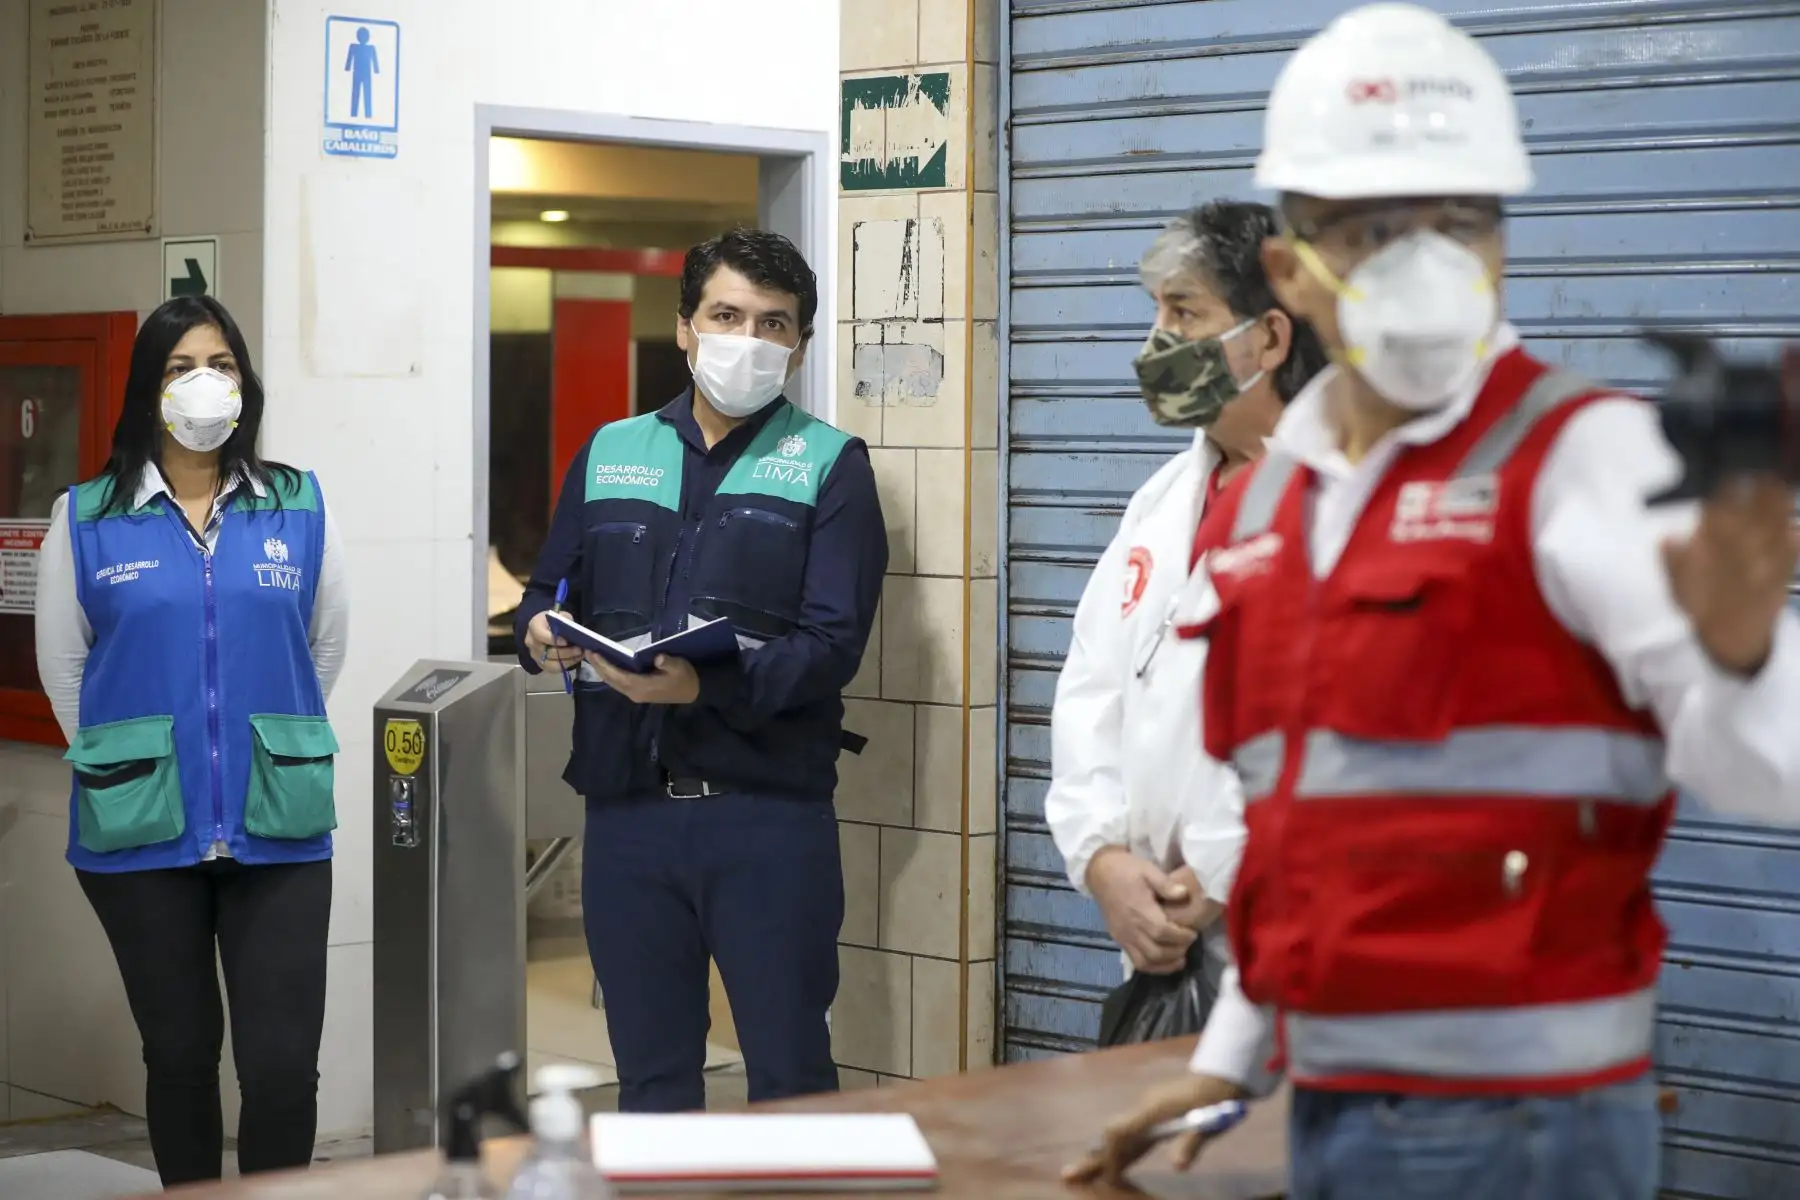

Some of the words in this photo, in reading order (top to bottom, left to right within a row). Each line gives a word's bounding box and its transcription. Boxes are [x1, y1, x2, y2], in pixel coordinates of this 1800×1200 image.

[325, 140, 396, 154] CABALLEROS
[21, 399, 34, 438] 6
[595, 464, 664, 478] DESARROLLO
[752, 464, 809, 486] LIMA
[595, 474, 659, 487] ECONÓMICO
[124, 559, 159, 571] DESARROLLO
[252, 563, 296, 572] MUNICIPALIDAD
[257, 570, 300, 592] LIMA
[386, 729, 422, 755] 0.50
